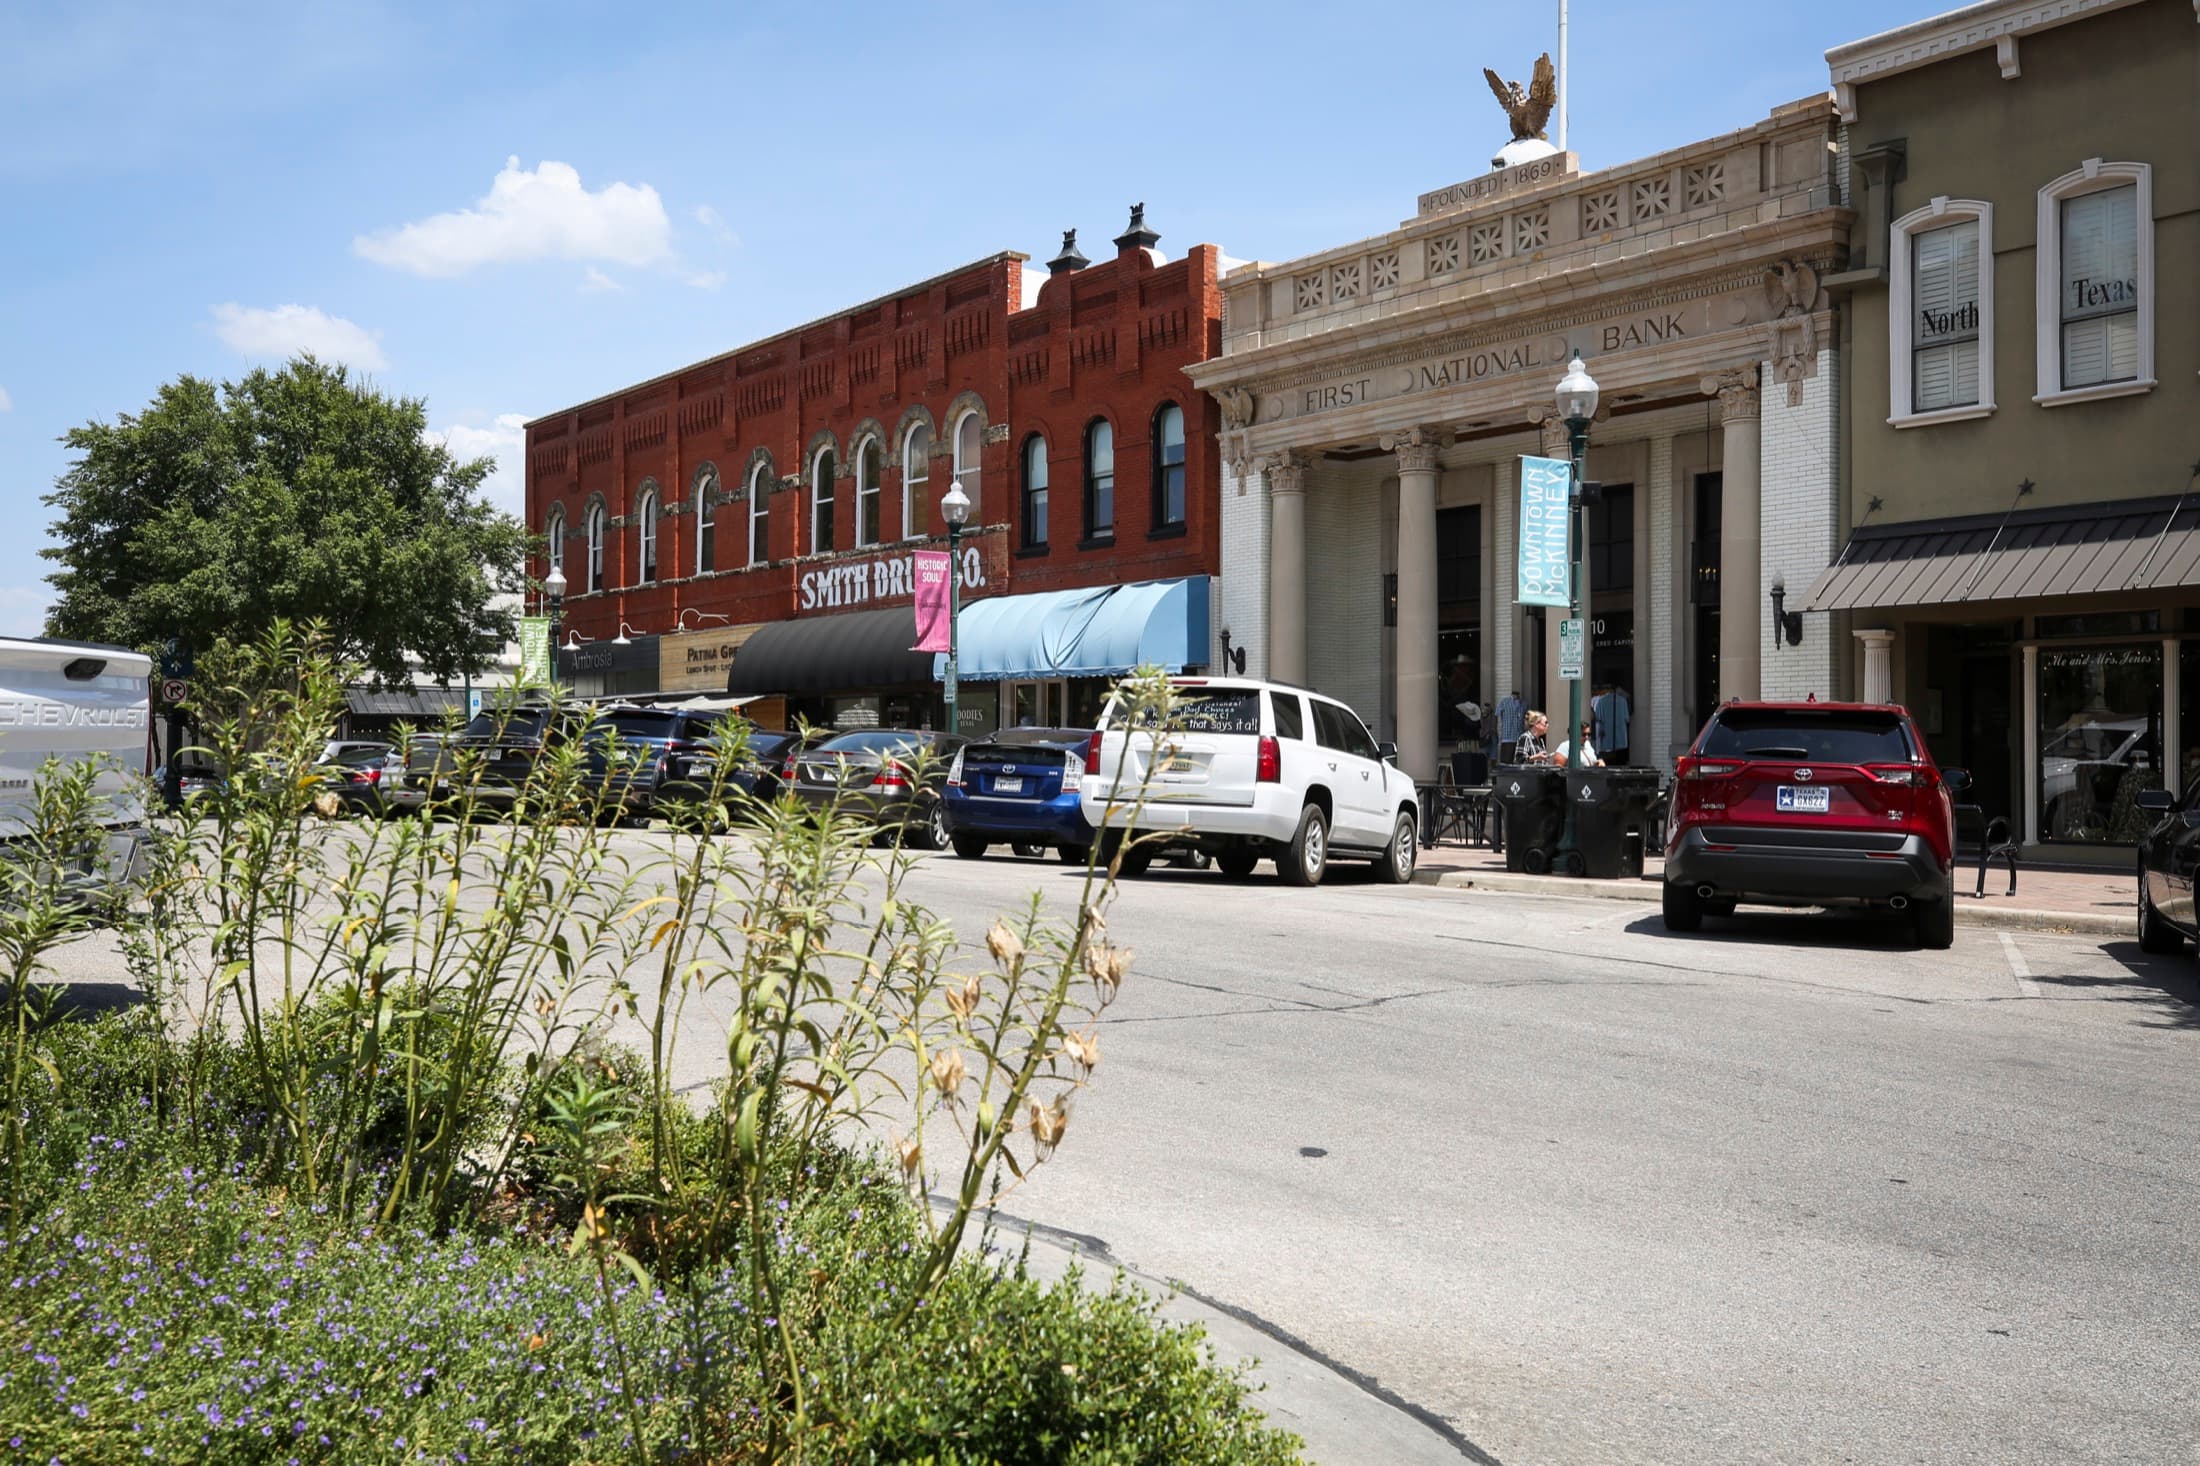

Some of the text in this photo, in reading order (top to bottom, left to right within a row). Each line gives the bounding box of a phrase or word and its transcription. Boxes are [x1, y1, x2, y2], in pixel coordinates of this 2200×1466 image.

[1430, 162, 1551, 209] FOUNDED 1869
[1921, 277, 2137, 337] North Texas
[1306, 312, 1685, 411] FIRST NATIONAL BANK
[1525, 468, 1544, 595] DOWNTOWN
[1545, 471, 1566, 597] McKINNEY
[801, 563, 869, 609] SMITH
[874, 557, 915, 598] DRU
[571, 650, 613, 670] Ambrosia
[0, 702, 147, 728] CHEVROLET
[957, 708, 983, 721] OODIES
[1189, 719, 1206, 729] that
[1211, 719, 1233, 731] says
[1235, 718, 1244, 731] it
